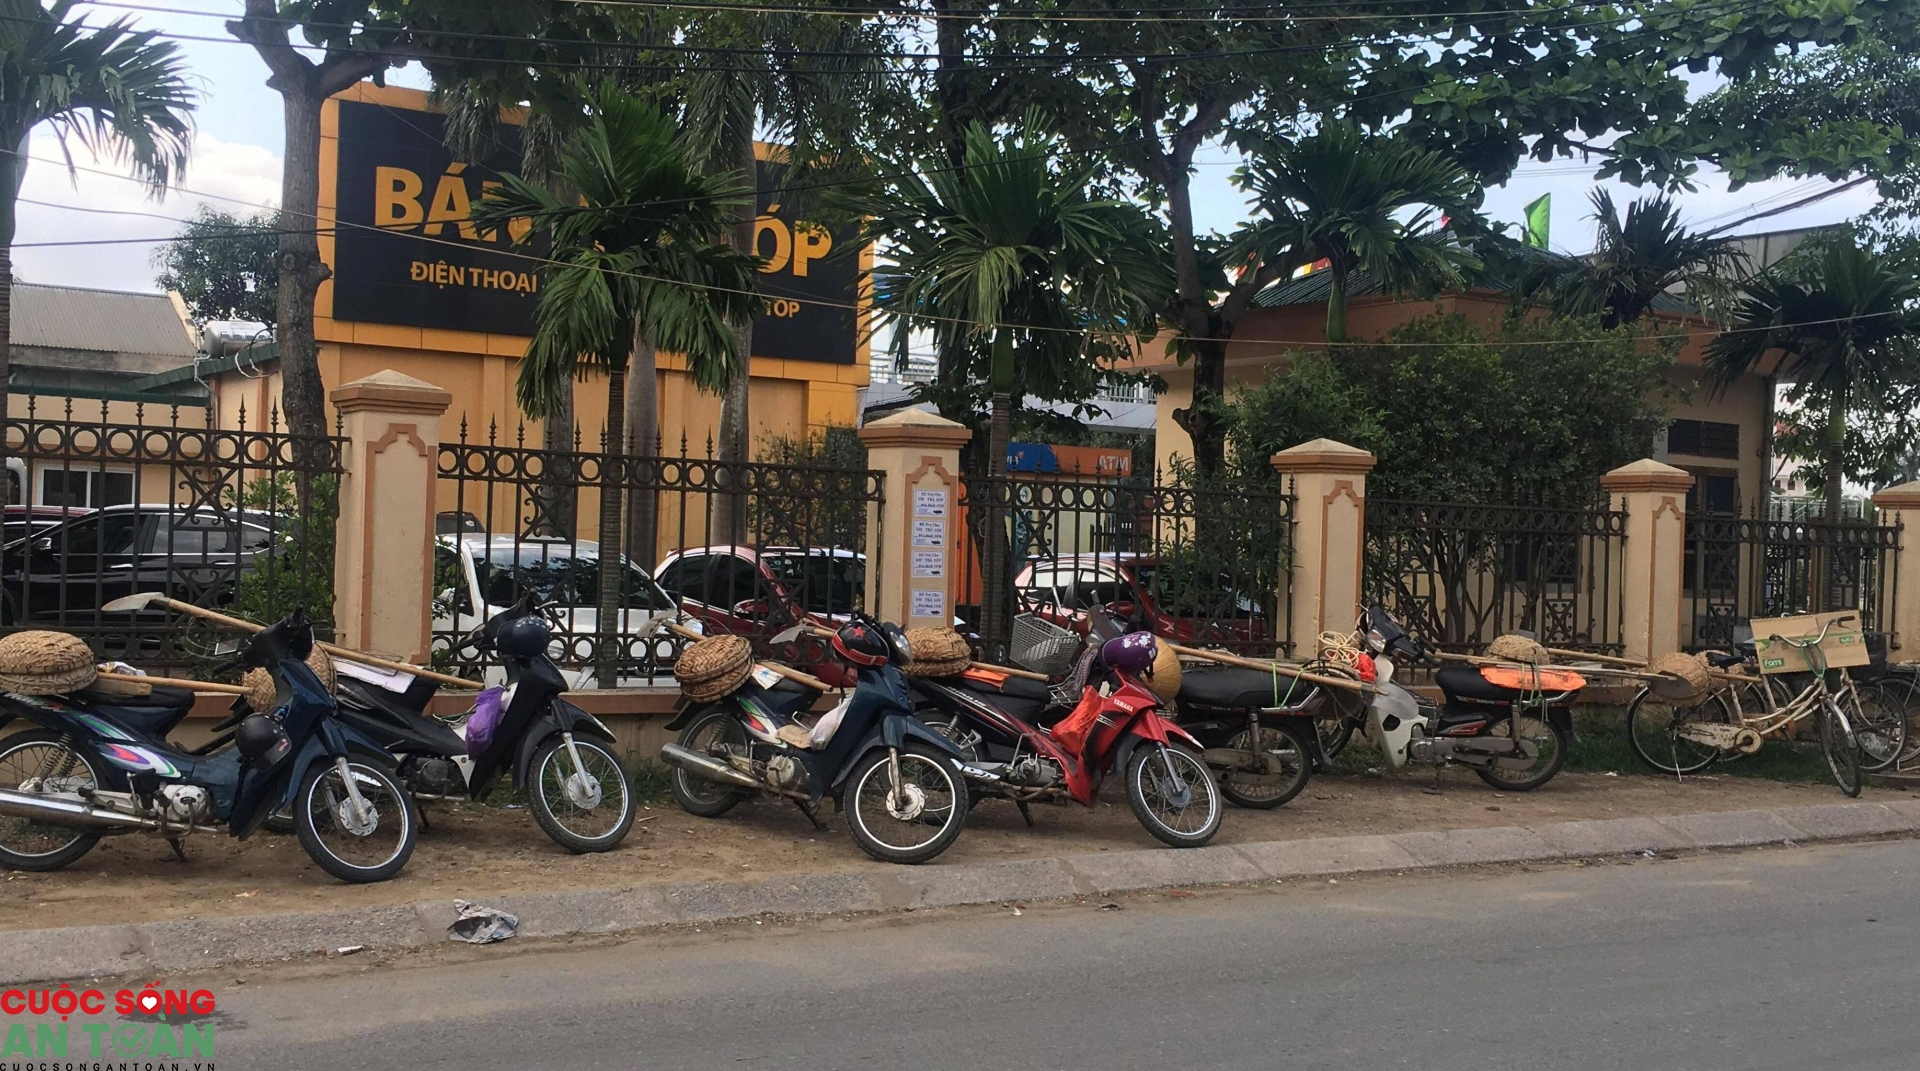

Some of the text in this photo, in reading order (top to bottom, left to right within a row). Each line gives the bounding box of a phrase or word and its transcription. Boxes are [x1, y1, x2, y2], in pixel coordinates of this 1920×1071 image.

[410, 260, 465, 289] ĐIỆN
[469, 267, 537, 297] THOẠI
[1099, 455, 1129, 471] ATM
[1113, 698, 1134, 713] YAMAHA
